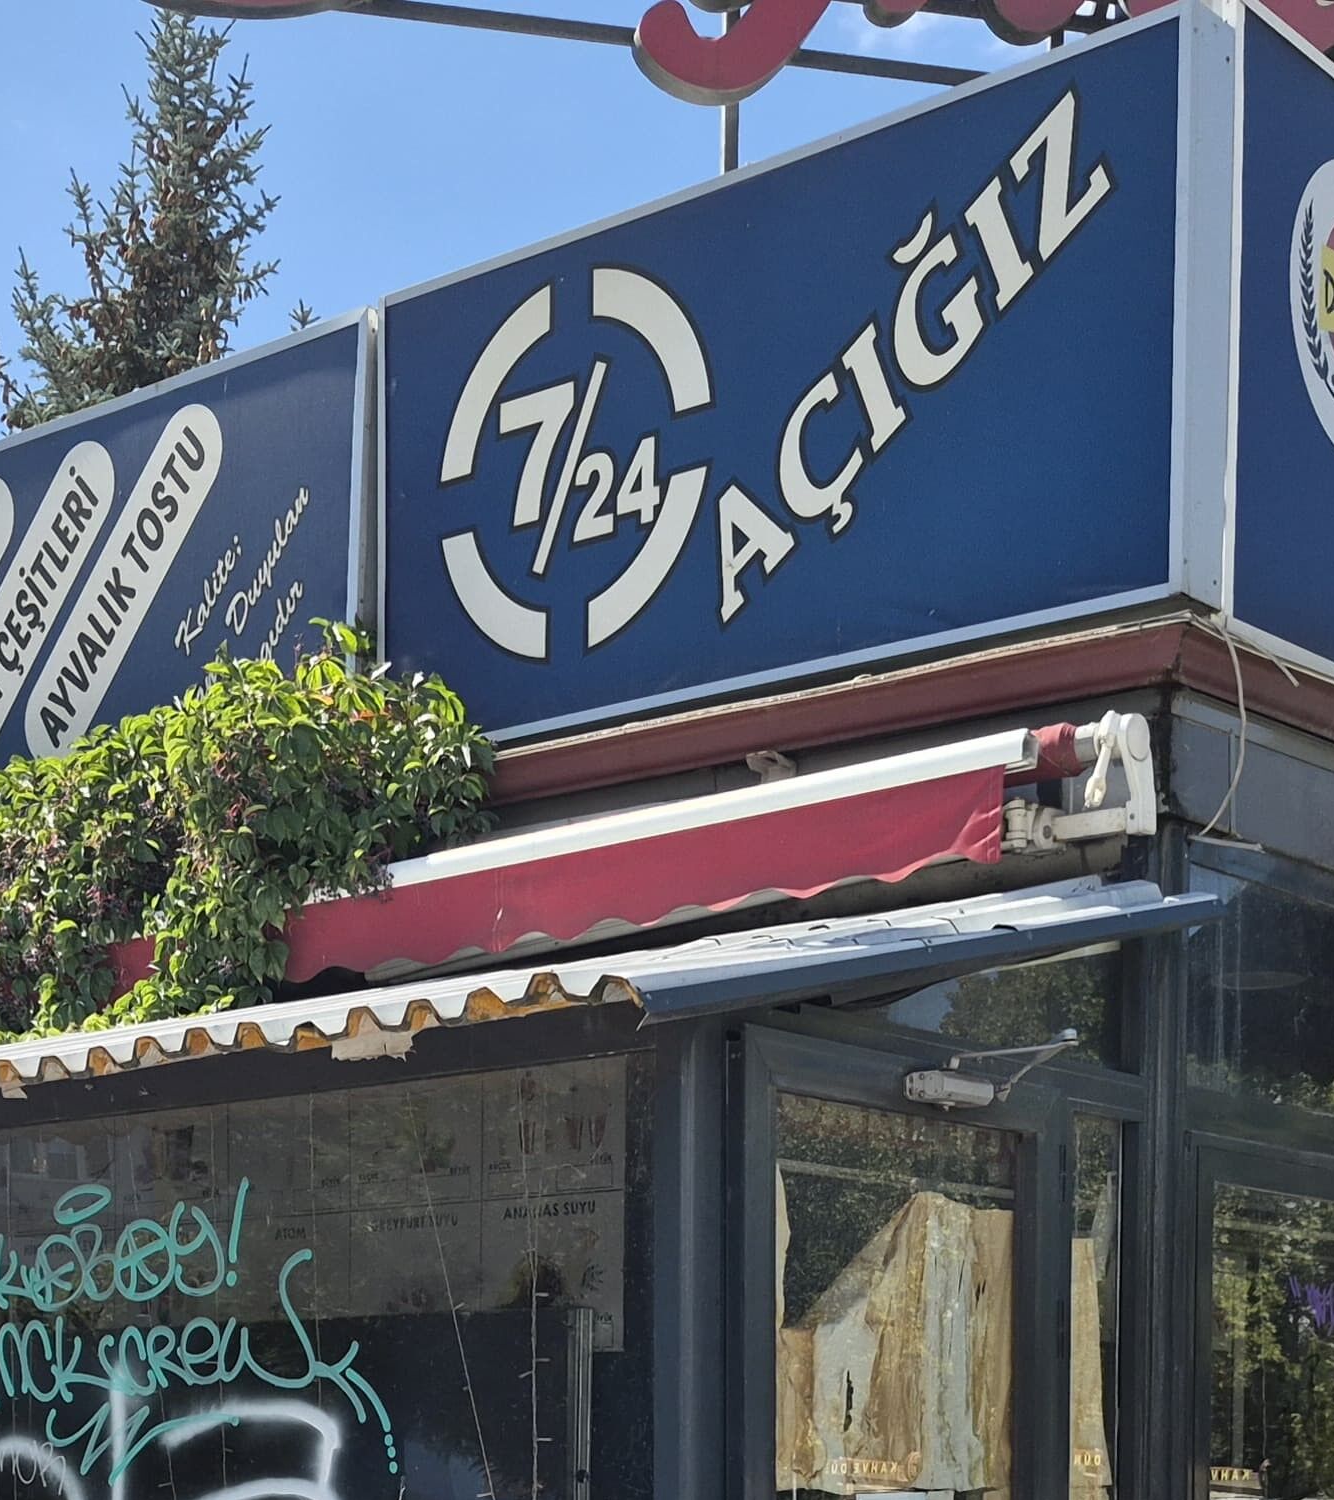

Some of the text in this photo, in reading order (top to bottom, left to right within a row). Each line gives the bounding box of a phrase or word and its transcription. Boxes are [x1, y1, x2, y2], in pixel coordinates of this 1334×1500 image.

[717, 91, 1113, 625] AÇIĞIZ
[499, 361, 663, 577] 7/24
[39, 425, 206, 749] AYVALIK TOSTU
[225, 487, 310, 636] Duyulan
[274, 1225, 307, 1241] ATOM
[563, 1200, 596, 1216] SUYU
